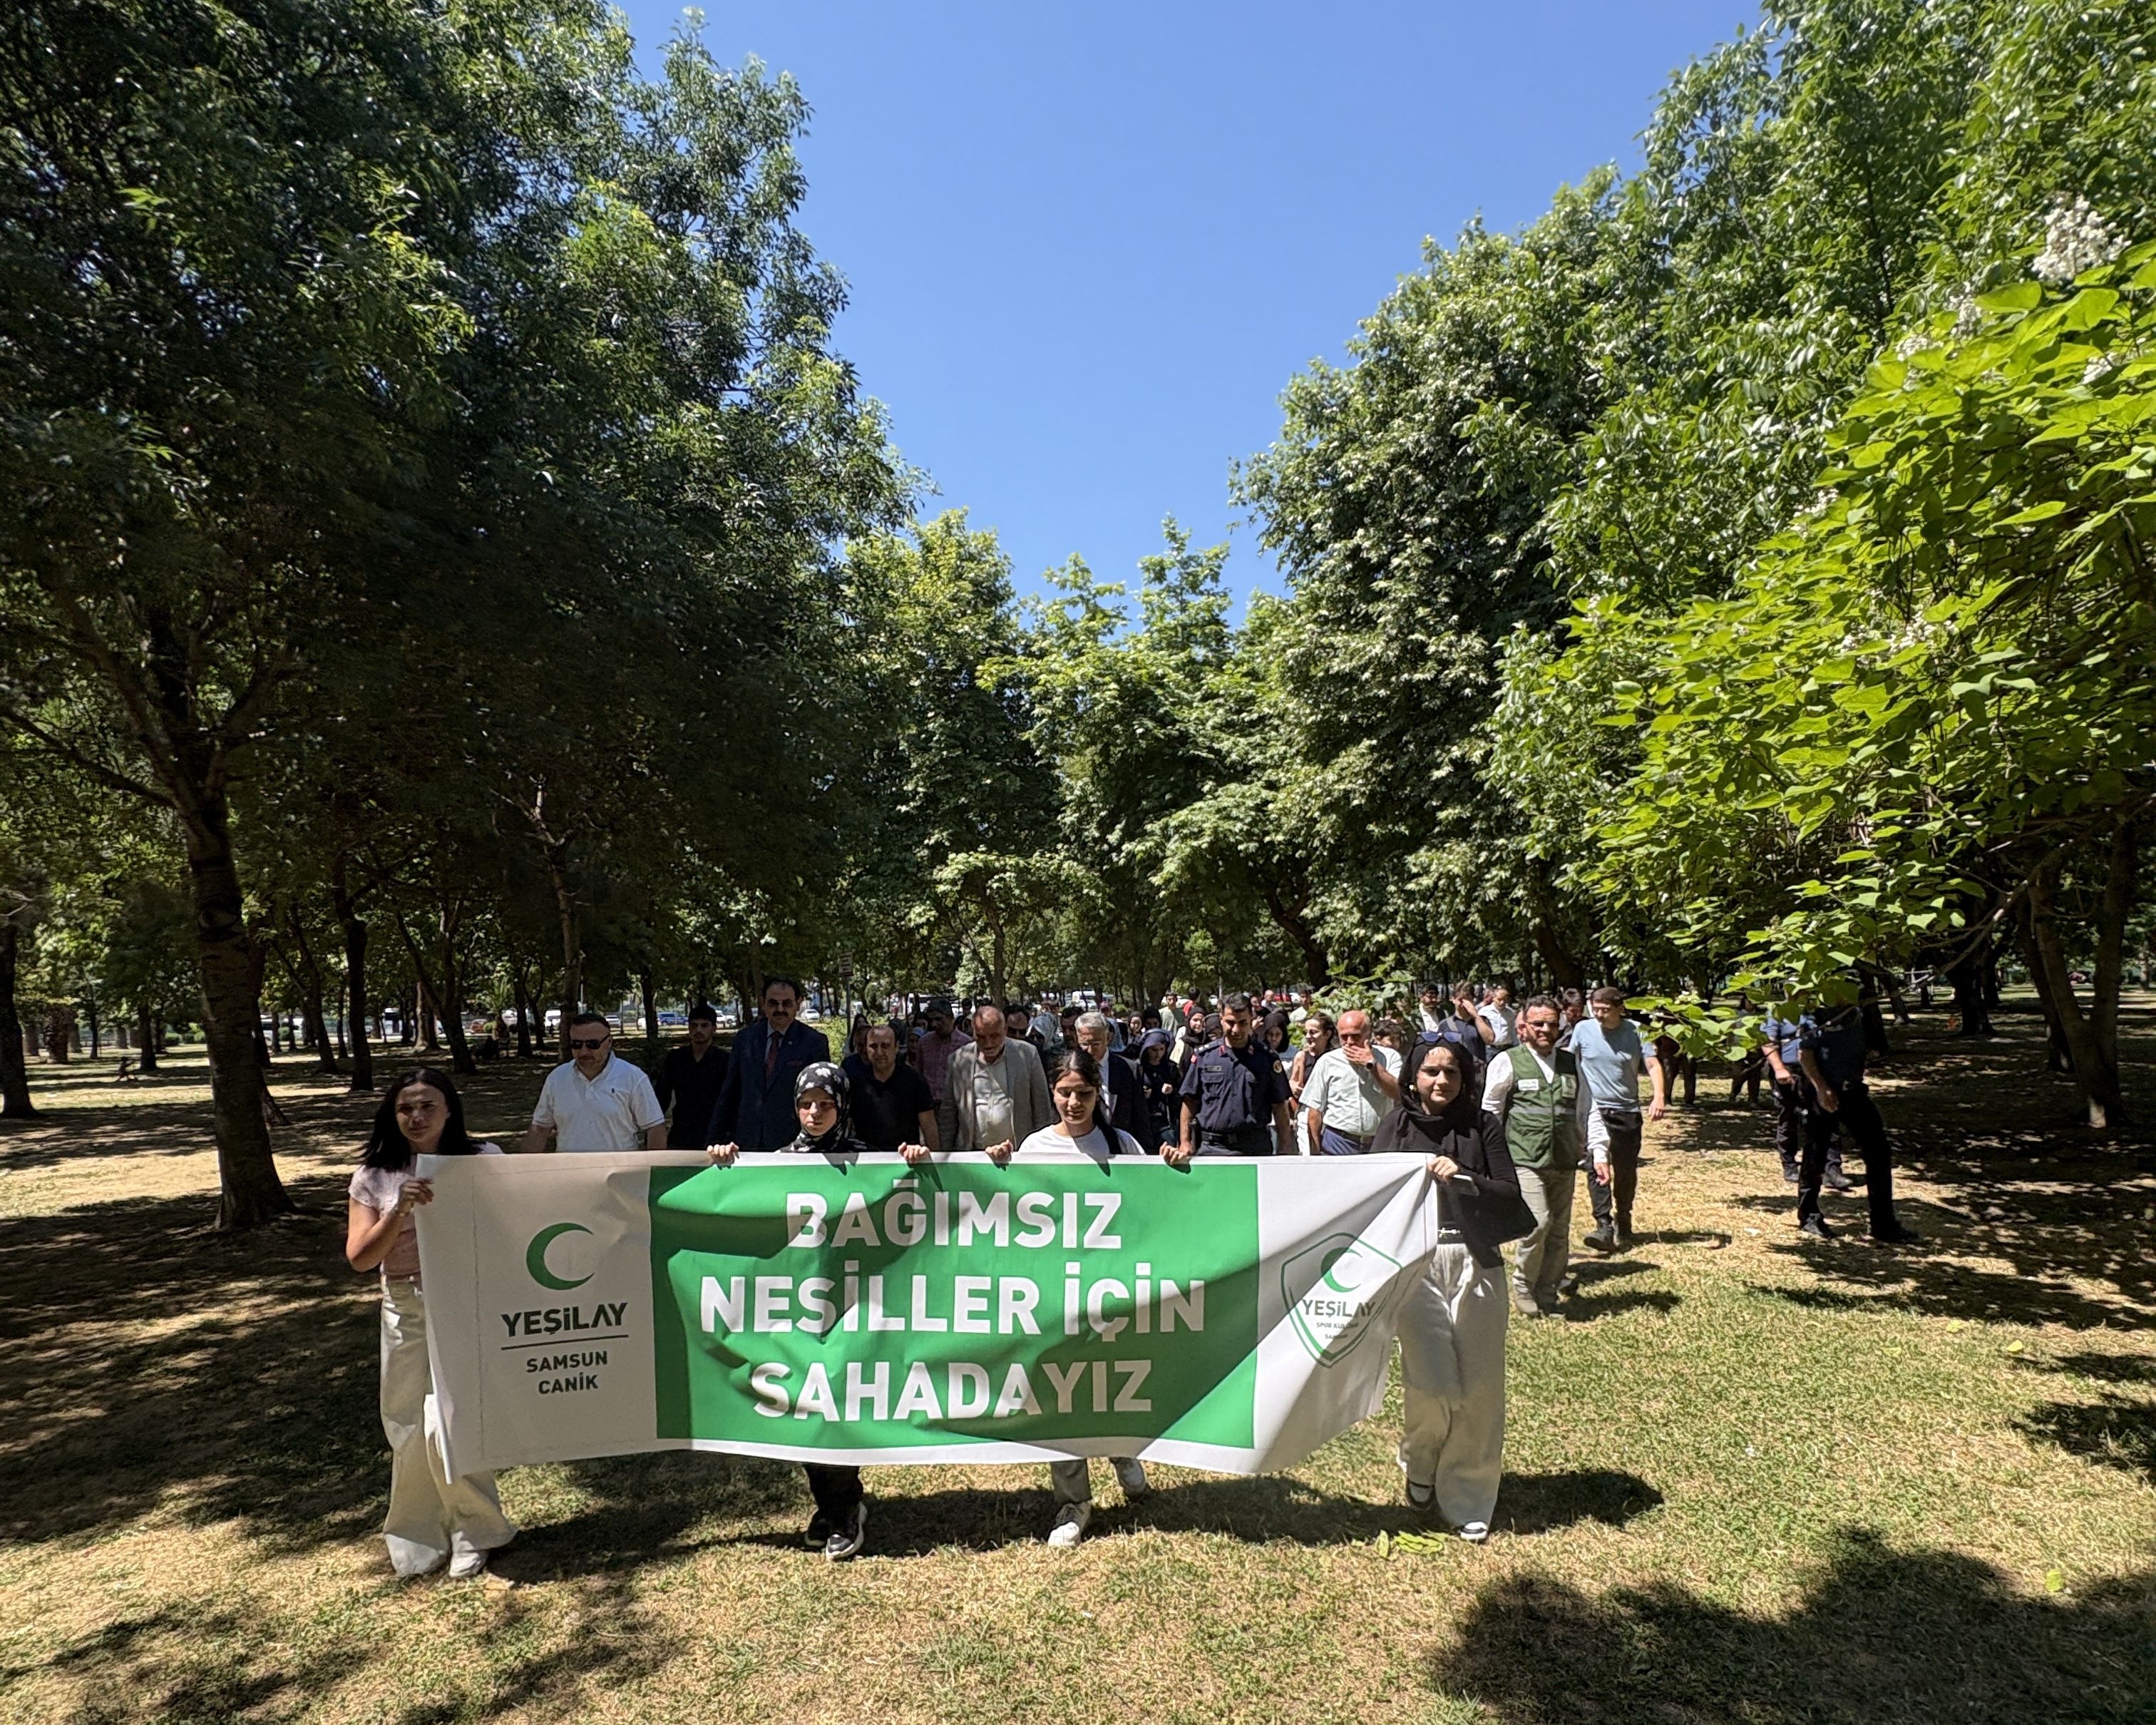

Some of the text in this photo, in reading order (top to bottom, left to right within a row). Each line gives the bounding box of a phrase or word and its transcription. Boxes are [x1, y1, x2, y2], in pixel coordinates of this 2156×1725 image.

[786, 1179, 1122, 1249] BAĞIMSIZ
[700, 1260, 1204, 1342] NESİLLER İÇİN
[526, 1351, 607, 1373] SAMSUN
[538, 1372, 598, 1395] CANİK
[751, 1360, 1152, 1421] SAHADAYIZ
